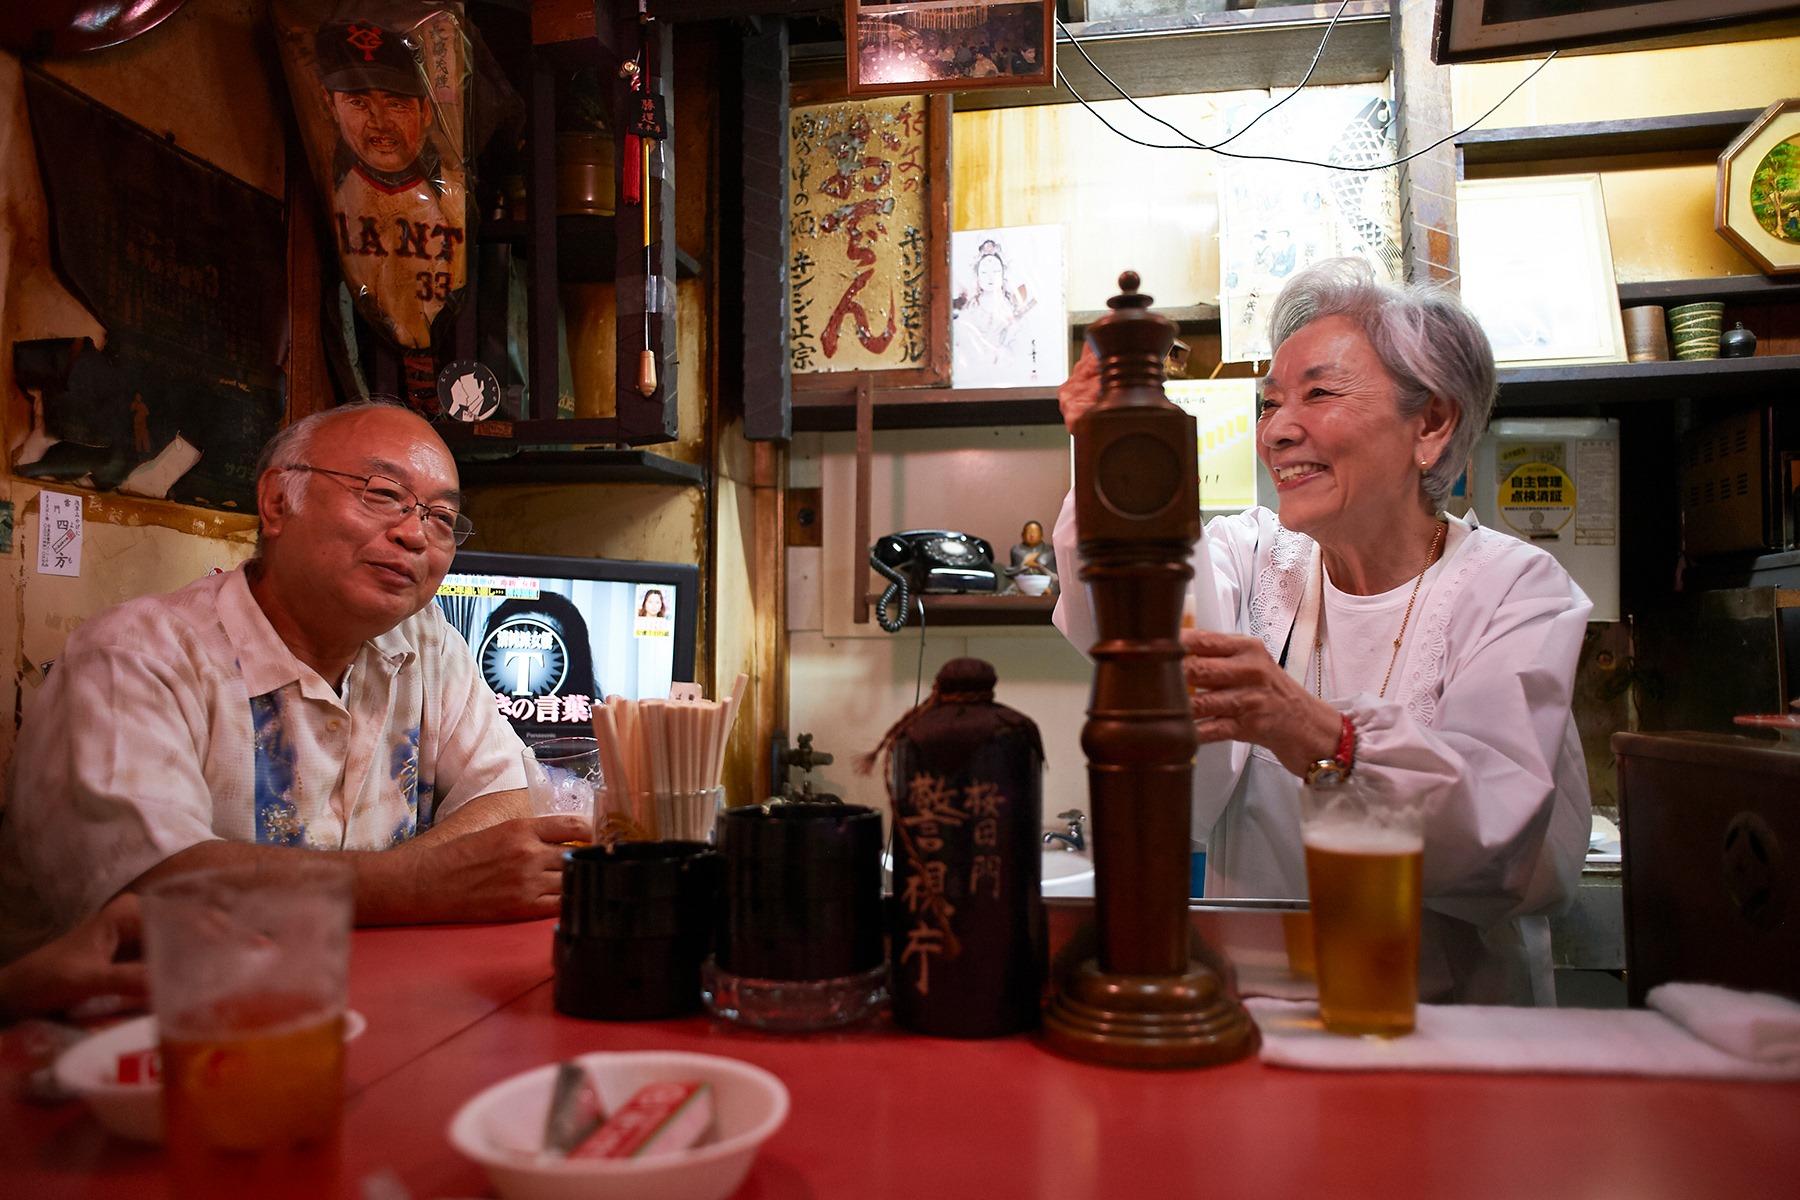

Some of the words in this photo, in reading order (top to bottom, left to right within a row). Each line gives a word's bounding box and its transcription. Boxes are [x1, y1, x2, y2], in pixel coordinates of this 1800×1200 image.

[820, 114, 897, 360] おでん
[415, 271, 452, 301] 33
[790, 251, 817, 370] キンシ正宗
[1511, 475, 1562, 489] 自主管理
[1511, 489, 1562, 503] 点検済証
[505, 651, 545, 697] T
[900, 772, 970, 996] 警視庁
